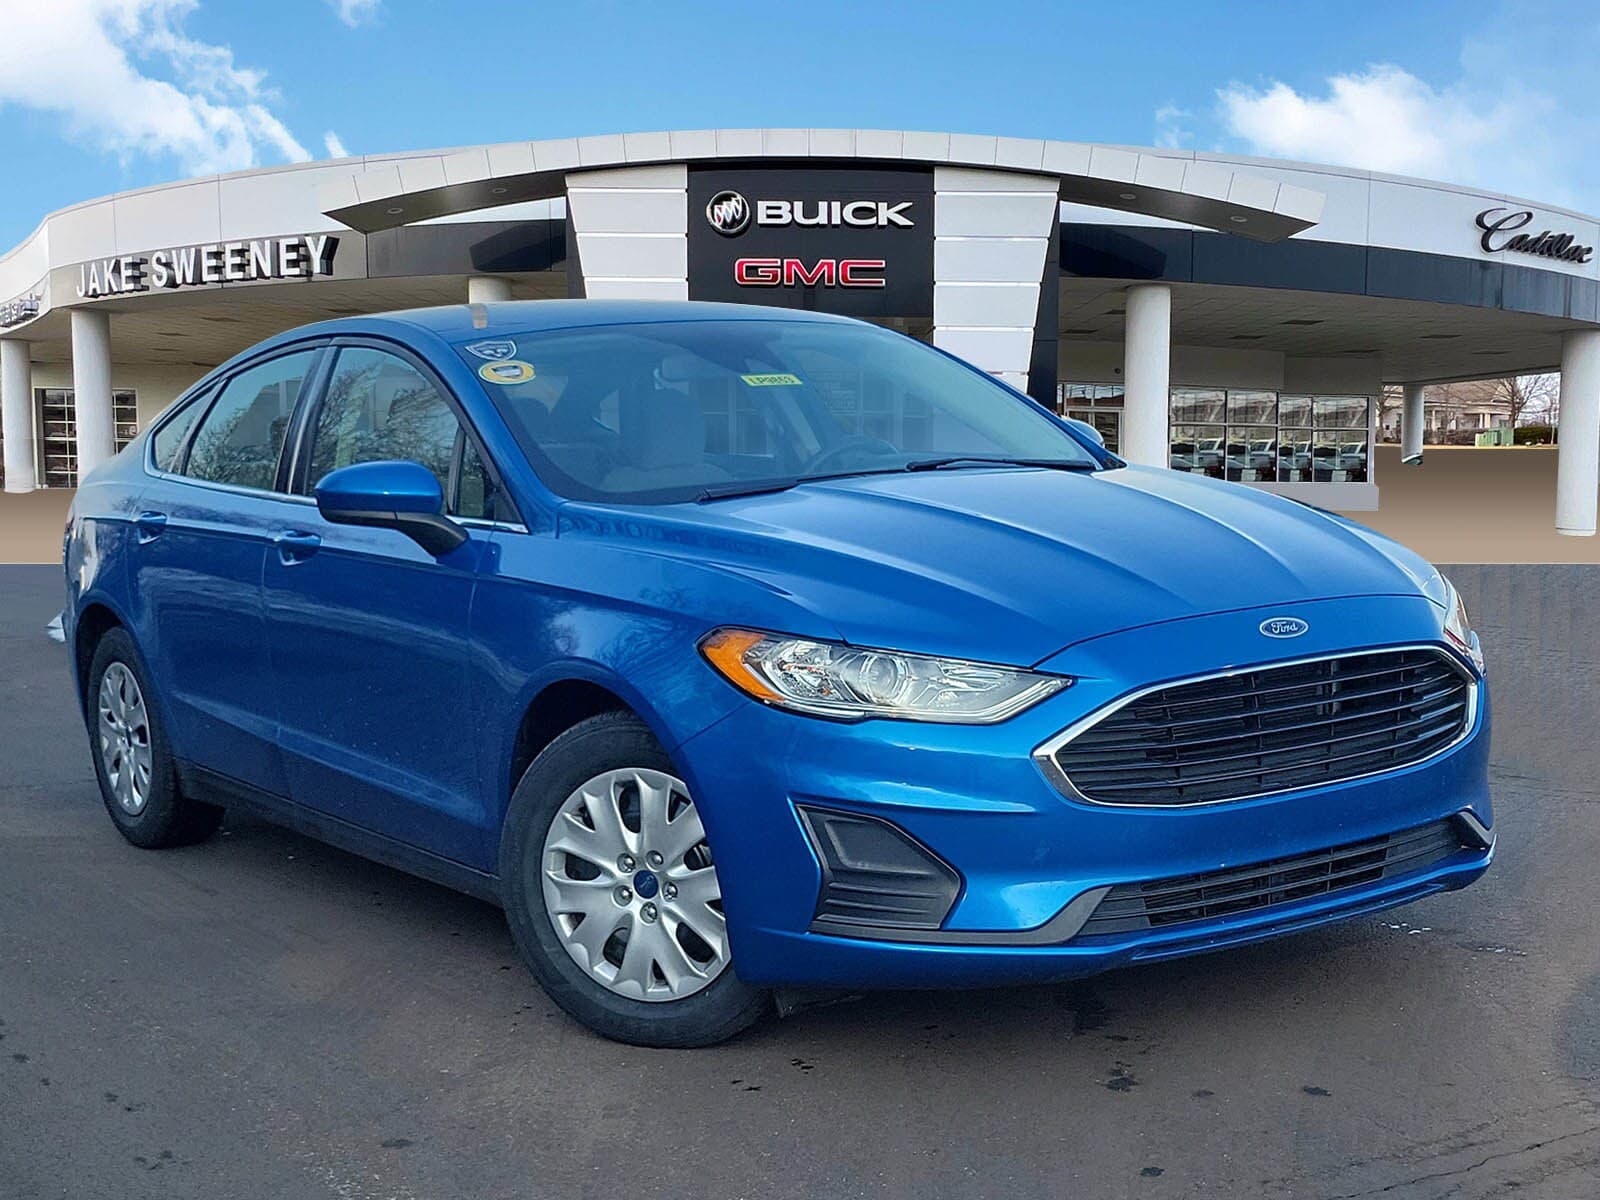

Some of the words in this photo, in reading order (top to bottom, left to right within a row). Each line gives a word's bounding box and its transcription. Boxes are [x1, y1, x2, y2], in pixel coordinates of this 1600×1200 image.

[757, 200, 915, 227] BUICK
[1475, 207, 1594, 264] Cadillac
[76, 256, 140, 298] JAKE
[151, 235, 333, 288] SWEENEY
[735, 258, 886, 287] GMC
[1270, 621, 1299, 634] Ford
